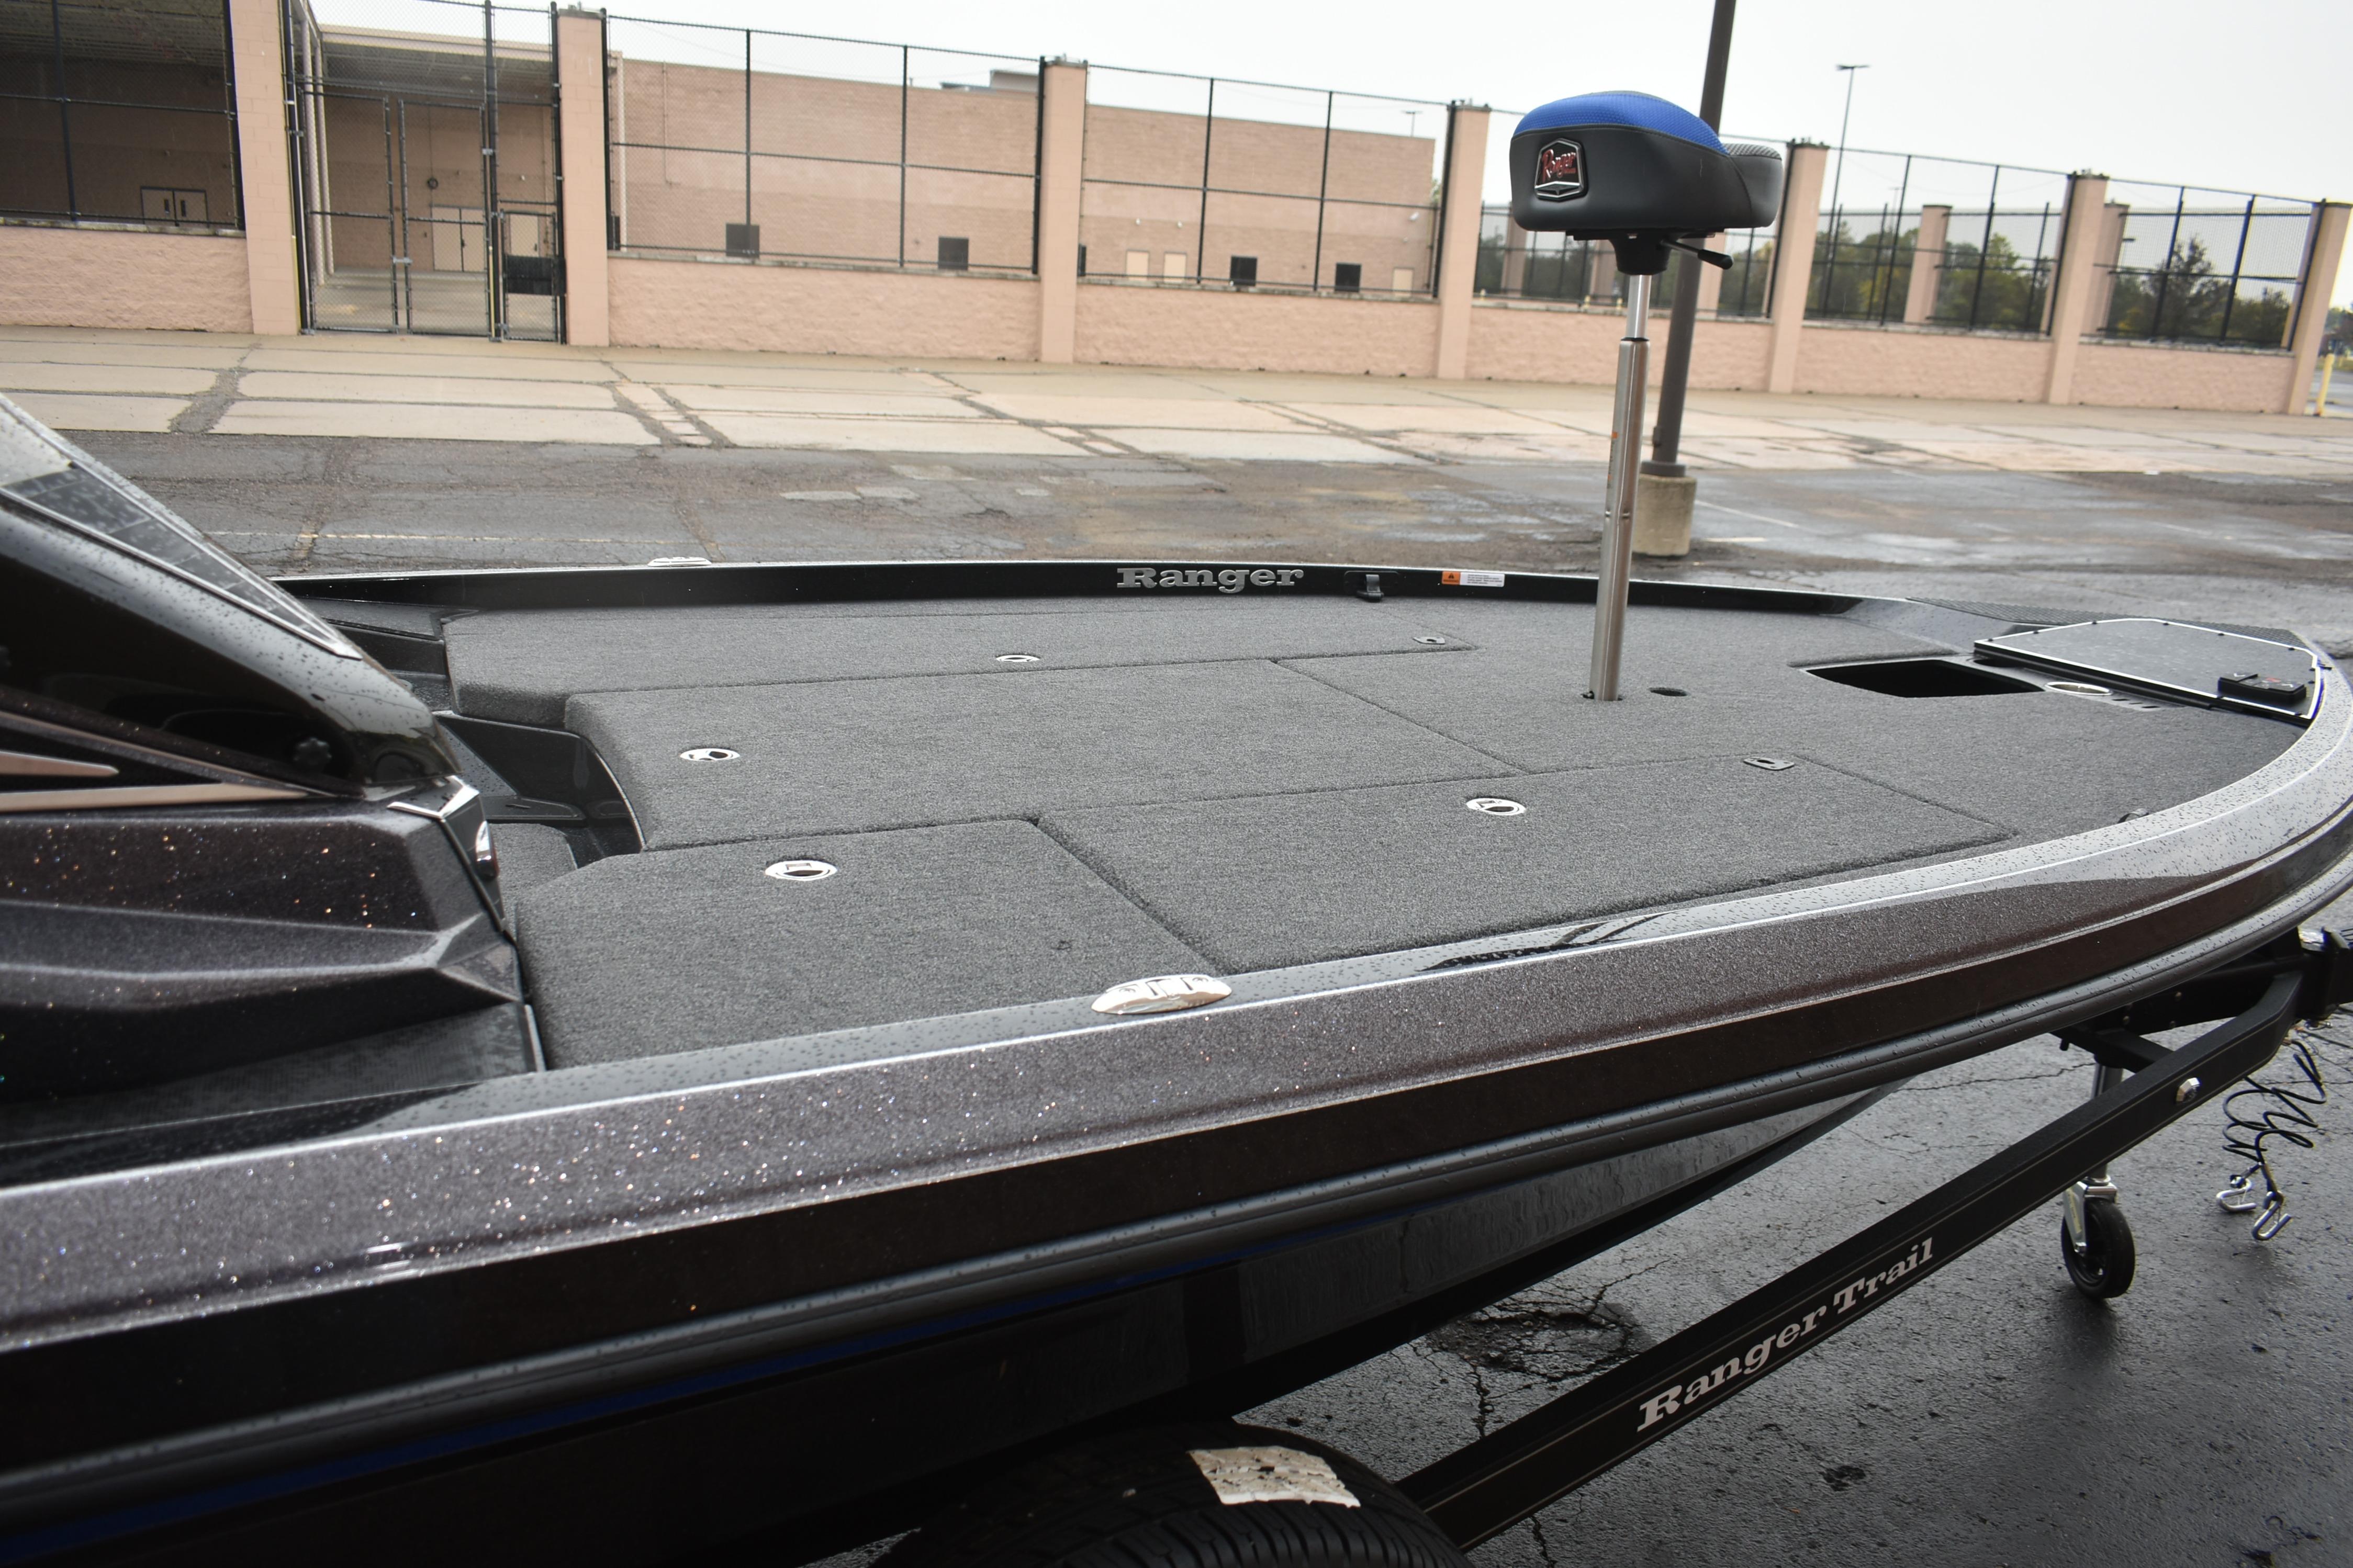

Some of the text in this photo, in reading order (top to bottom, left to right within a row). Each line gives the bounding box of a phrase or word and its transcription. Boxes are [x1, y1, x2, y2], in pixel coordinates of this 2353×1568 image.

[1117, 568, 1304, 593] Ranger
[1637, 1237, 1933, 1432] Ranger Trail
